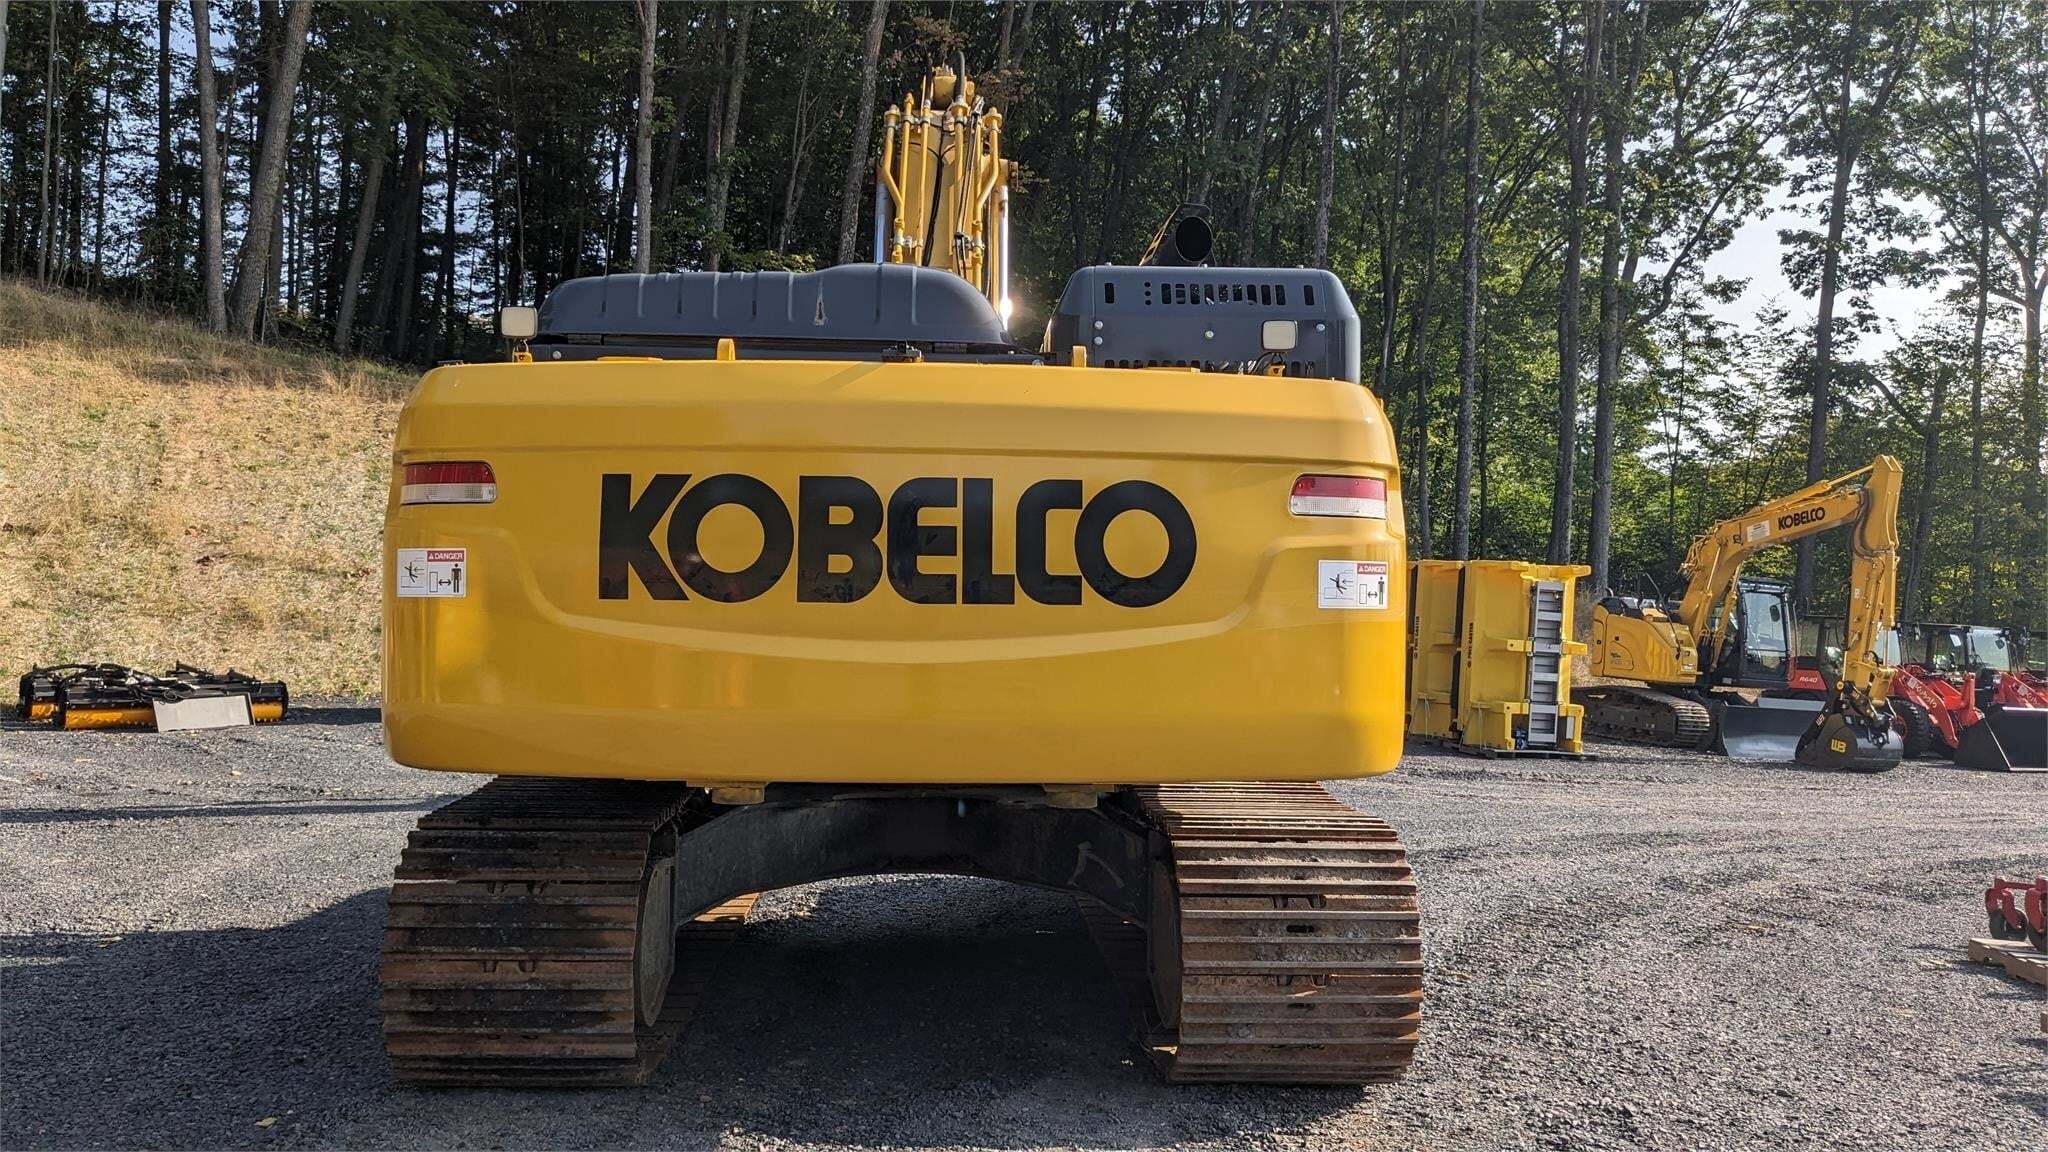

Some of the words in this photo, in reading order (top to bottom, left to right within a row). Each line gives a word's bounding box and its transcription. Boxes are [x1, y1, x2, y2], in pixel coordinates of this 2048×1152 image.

[1778, 507, 1825, 530] KOBELCO
[599, 473, 1197, 608] KOBELCO
[1364, 565, 1386, 573] DANGER
